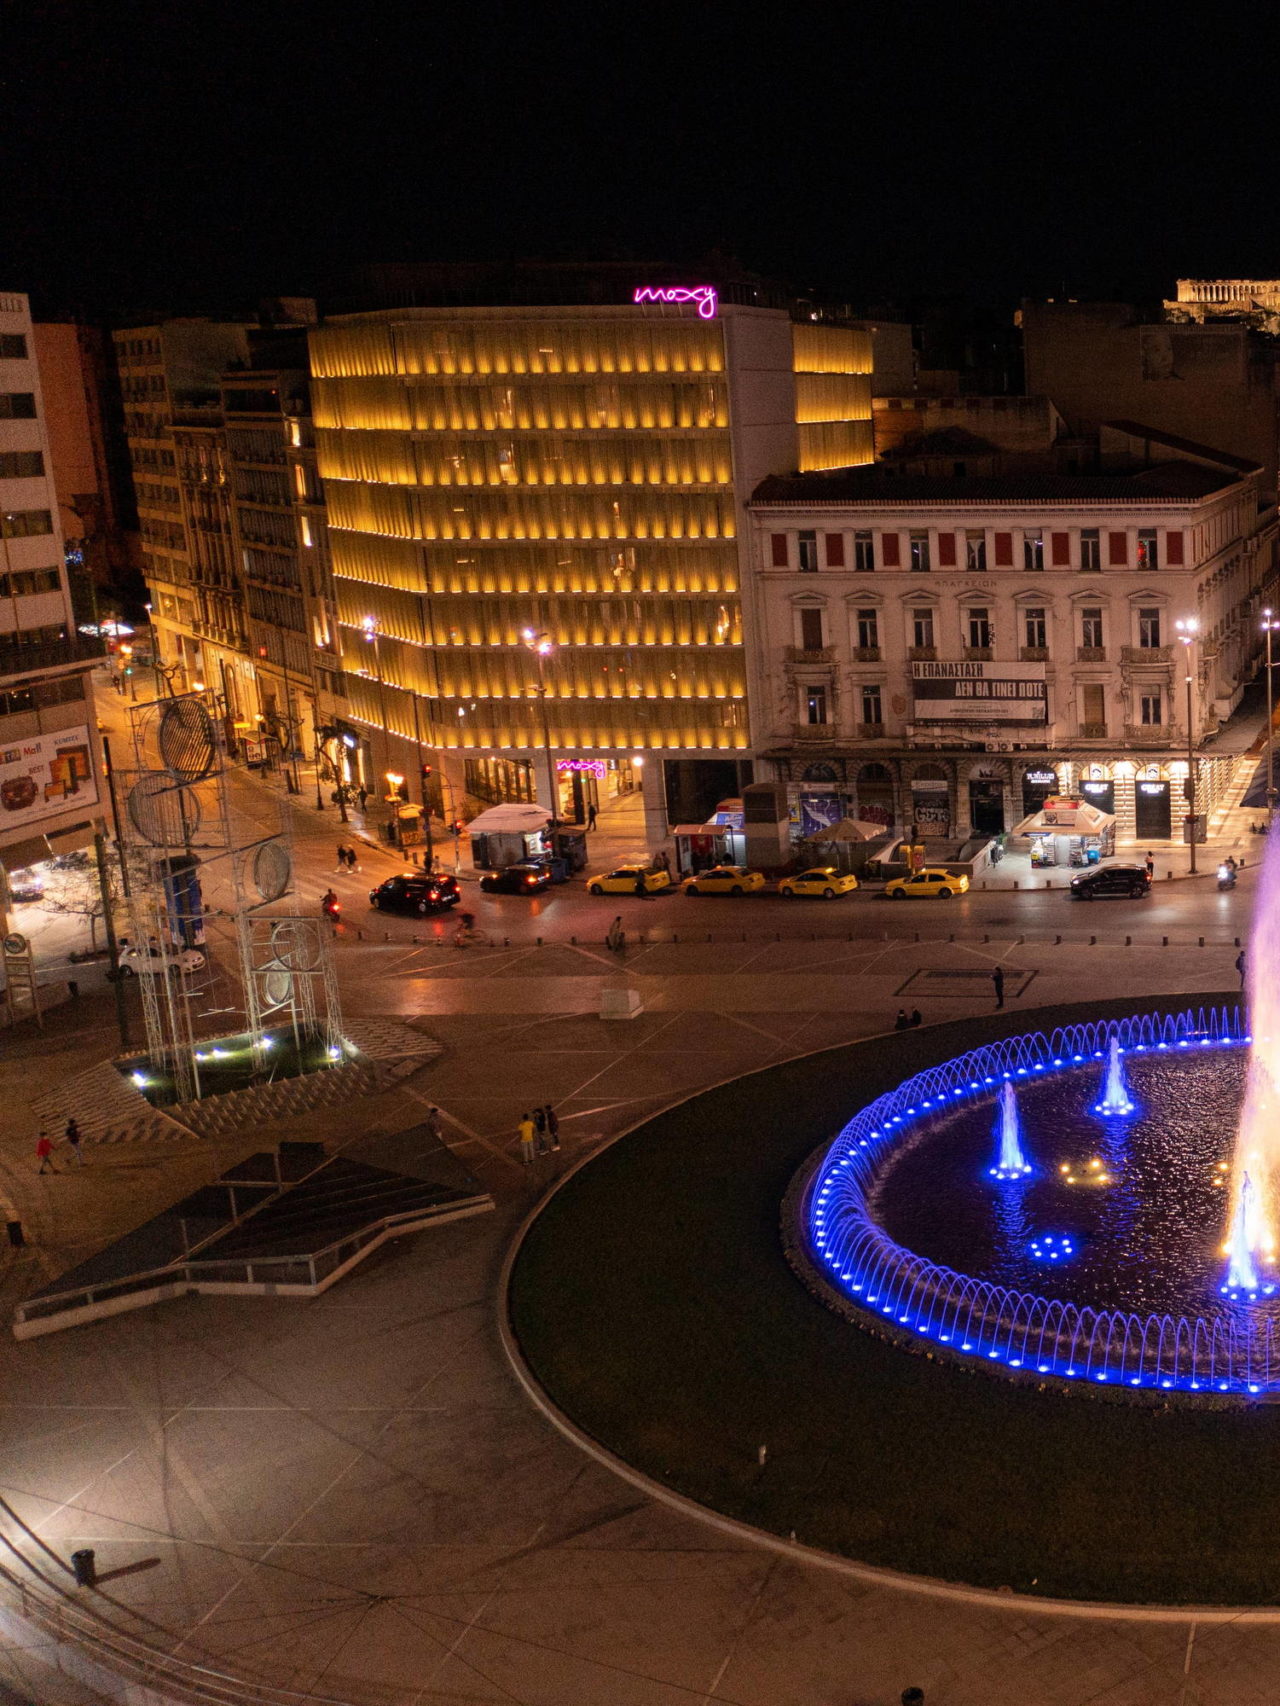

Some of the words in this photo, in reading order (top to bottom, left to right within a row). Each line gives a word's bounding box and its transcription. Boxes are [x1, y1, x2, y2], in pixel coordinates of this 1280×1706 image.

[634, 286, 716, 319] moxy
[913, 663, 921, 678] Η
[922, 663, 984, 678] ΕΠΑΝΑΣΤΑΣΗ
[955, 681, 973, 697] ΔΕΝ
[975, 681, 990, 697] ΘΑ
[992, 682, 1017, 697] ΓΙΝΕΙ
[1018, 682, 1044, 697] ΠΟΤΕ
[556, 761, 606, 779] moxy
